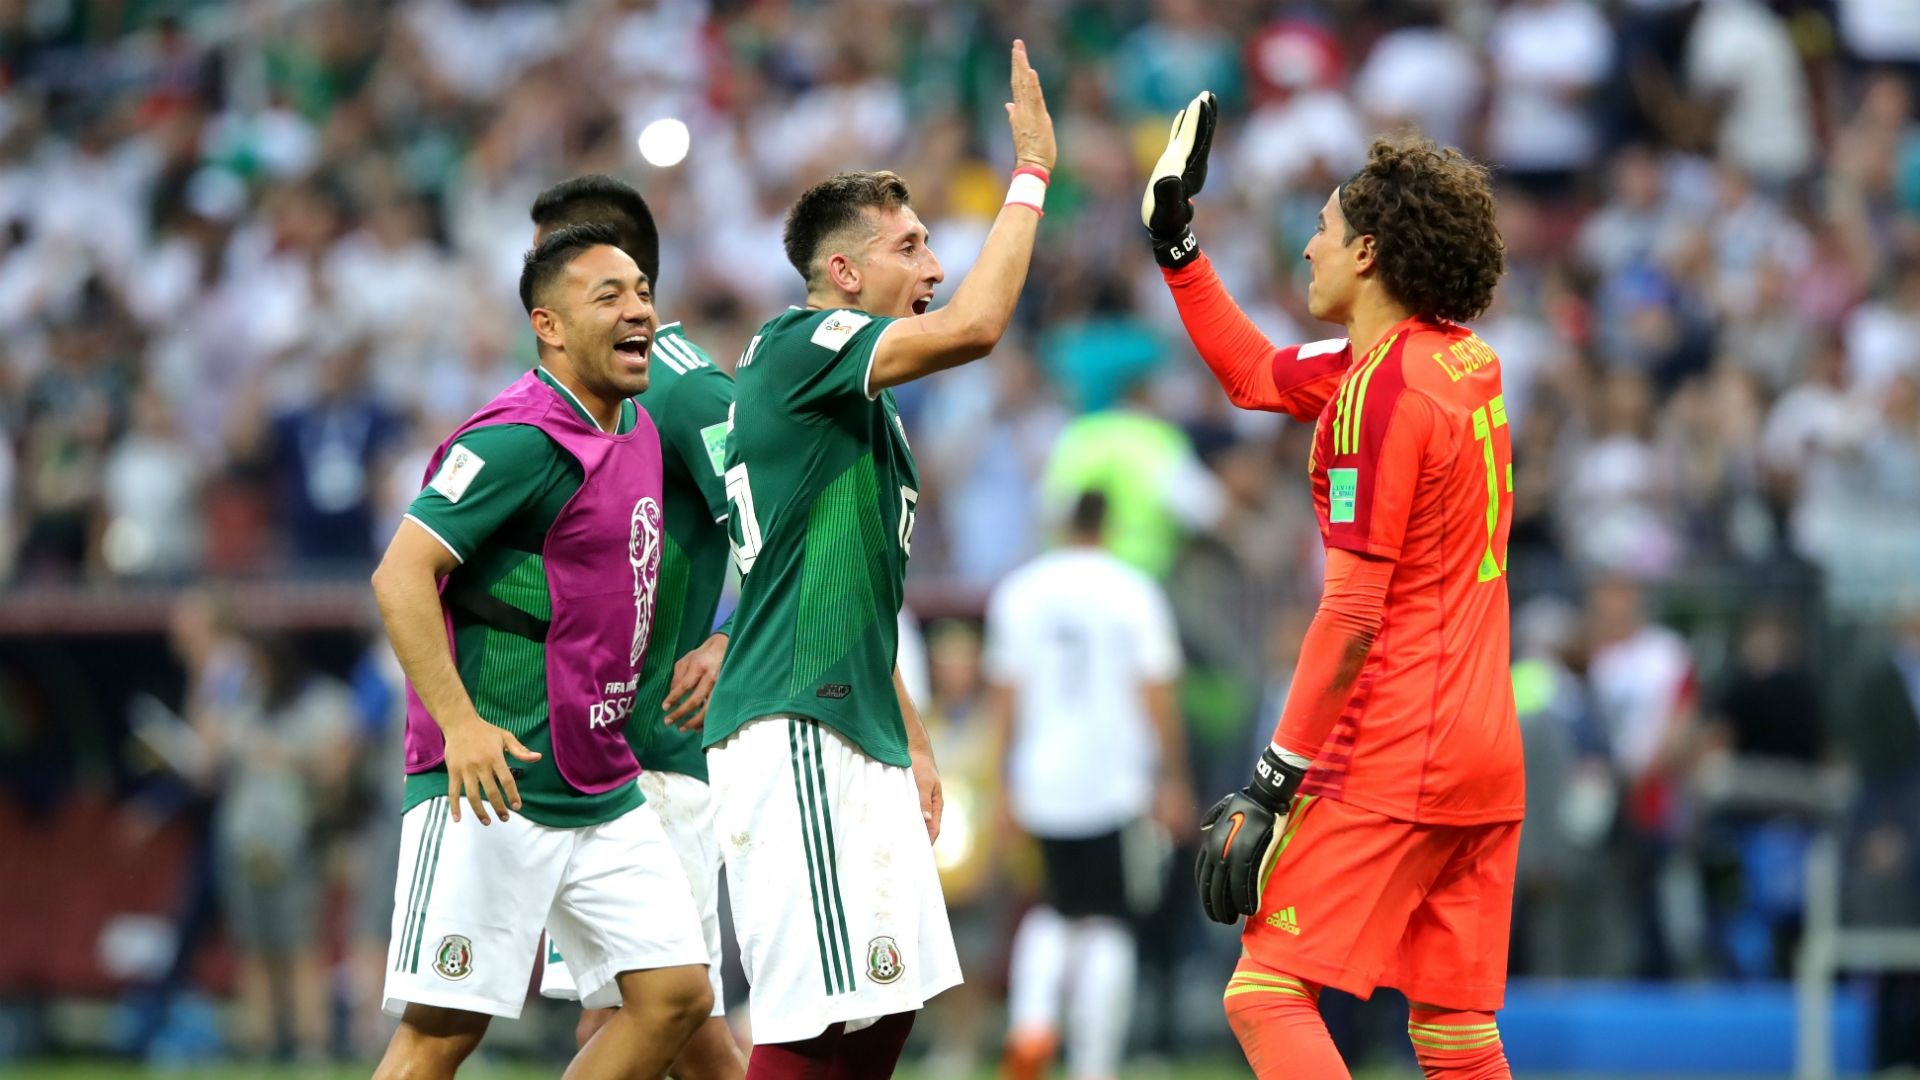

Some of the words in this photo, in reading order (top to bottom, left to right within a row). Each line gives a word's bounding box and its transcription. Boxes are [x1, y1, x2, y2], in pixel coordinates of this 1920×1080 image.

[1170, 246, 1185, 260] G.
[605, 682, 625, 694] FIFA
[1271, 770, 1285, 787] G.
[1266, 916, 1300, 936] adidas
